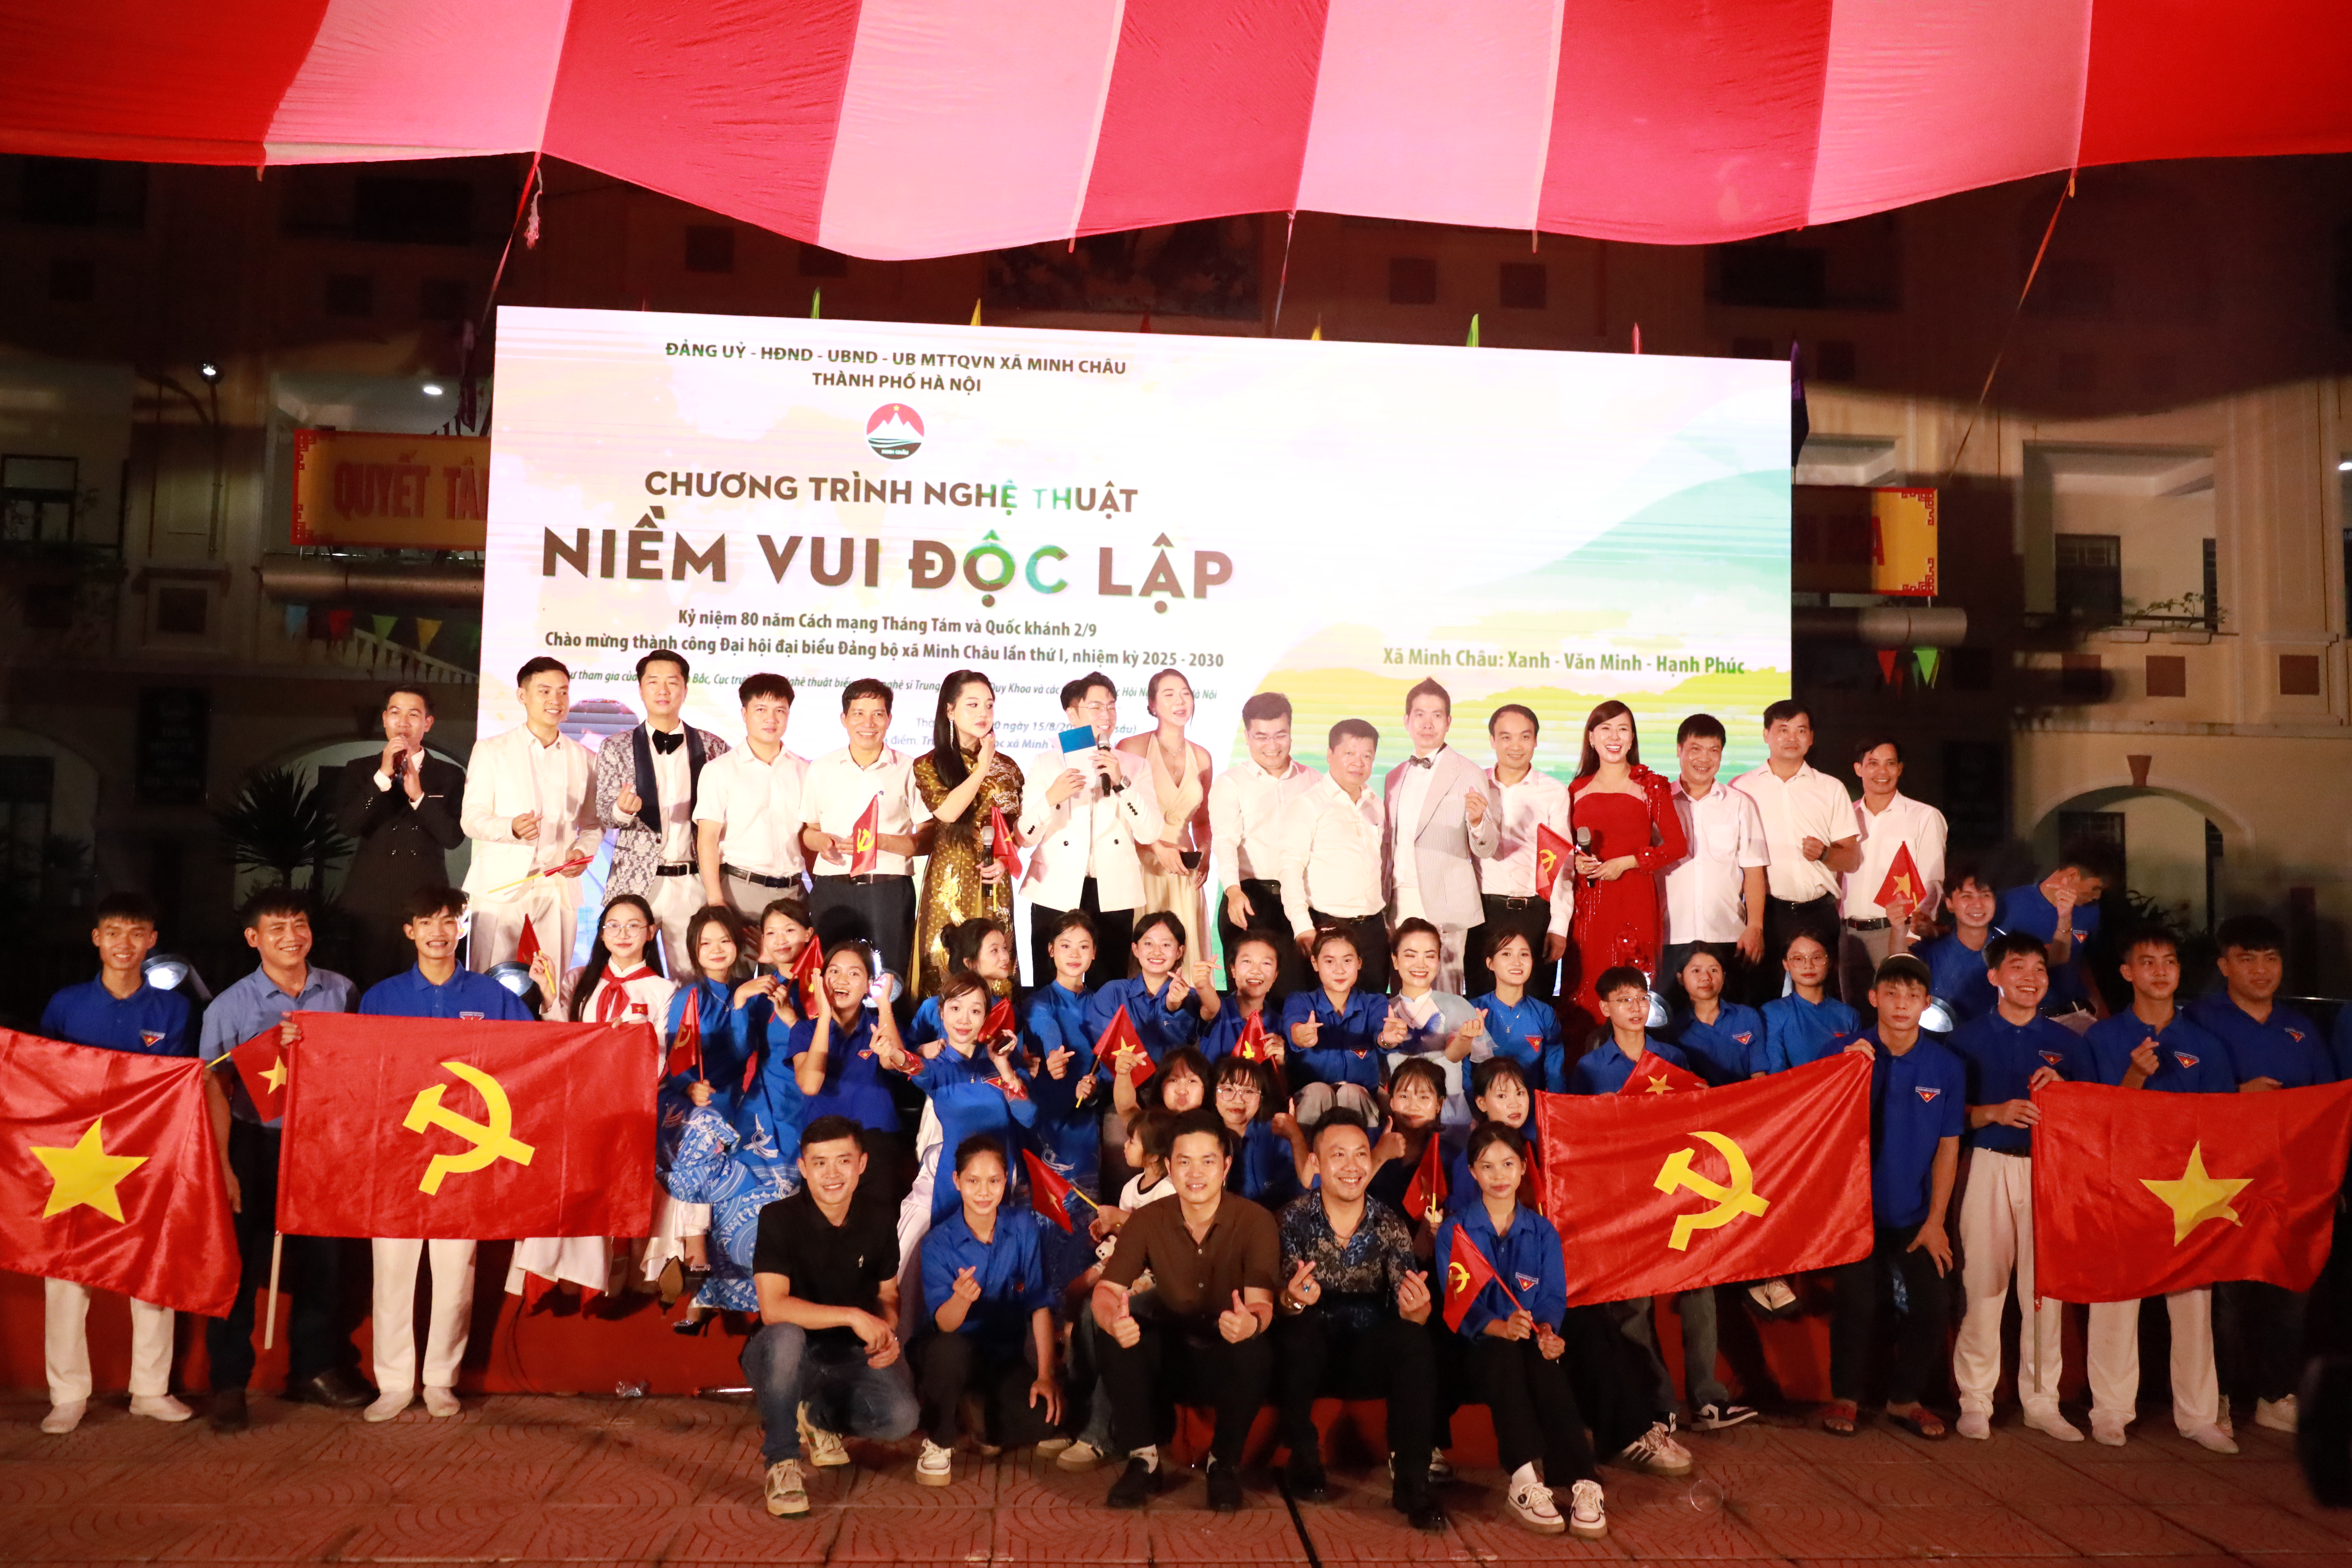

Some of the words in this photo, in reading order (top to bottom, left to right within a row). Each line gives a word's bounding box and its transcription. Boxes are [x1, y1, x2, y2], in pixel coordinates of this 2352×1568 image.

[666, 340, 717, 357] ĐẢNG
[723, 342, 746, 358] UỶ
[761, 347, 813, 361] HĐND
[828, 350, 877, 364] UBND
[893, 353, 915, 365] UB
[921, 354, 994, 369] MTTQVN
[1000, 354, 1022, 369] XÃ
[1028, 358, 1073, 372] MINH
[1079, 358, 1125, 374] CHÂU
[813, 371, 873, 387] THÀNH
[879, 372, 916, 389] PHỐ
[921, 375, 945, 390] HÀ
[950, 376, 980, 395] NỘI
[334, 450, 430, 521] QUYẾT
[645, 471, 798, 500] CHƯƠNG
[808, 471, 911, 504] TRÌNH
[925, 480, 1017, 516] NGHỆ
[1034, 481, 1138, 519] THUẬT
[543, 506, 726, 582] NIỀM
[757, 535, 879, 587] VUI
[908, 530, 1068, 608] ĐỘC
[1099, 532, 1233, 614] LẬP
[679, 609, 696, 627] Kỷ
[700, 610, 737, 628] niệm
[741, 612, 758, 625] 80
[763, 613, 795, 627] năm
[799, 614, 831, 628] Cách
[836, 619, 877, 633] mạng
[882, 616, 927, 635] Tháng
[931, 618, 961, 632] Tám
[965, 619, 981, 633] và
[986, 619, 1021, 635] Quốc
[1025, 621, 1070, 635] khánh
[1074, 623, 1096, 637] 2/9
[545, 632, 581, 646] Chào
[586, 633, 628, 652] mừng
[633, 634, 677, 650] thành
[681, 640, 716, 654] công
[720, 638, 744, 655] Đại
[749, 638, 771, 656] hội
[776, 639, 798, 657] đại
[802, 638, 833, 654] biểu
[838, 640, 876, 659] Đảng
[881, 642, 898, 660] bộ
[902, 643, 918, 657] xã
[923, 644, 959, 658] Minh
[964, 645, 998, 659] Châu
[1004, 645, 1026, 660] lần
[1030, 648, 1056, 661] thứ
[1060, 648, 1068, 664] I,
[1073, 649, 1118, 667] nhiệm
[1123, 650, 1139, 668] kỳ
[1143, 652, 1176, 665] 2025
[1189, 653, 1223, 667] 2030
[1383, 648, 1403, 664] Xã
[1409, 649, 1451, 666] Minh
[1456, 650, 1503, 667] Châu:
[1508, 651, 1549, 668] Xanh
[1565, 653, 1595, 669] Văn
[1601, 654, 1641, 671] Minh
[1657, 655, 1699, 677] Hạnh
[1705, 657, 1744, 674] Phúc
[579, 670, 603, 680] tham
[605, 671, 620, 683] gia
[714, 674, 729, 686] Cục
[808, 677, 833, 689] thuật
[916, 680, 940, 692] Trung
[1008, 683, 1031, 693] Khoa
[1034, 684, 1043, 694] và
[1046, 684, 1060, 694] các
[1122, 687, 1136, 698] Hội
[1202, 689, 1217, 701] Nội
[1003, 721, 1029, 732] ngày
[1007, 739, 1019, 748] xã
[1022, 739, 1048, 749] Minh
